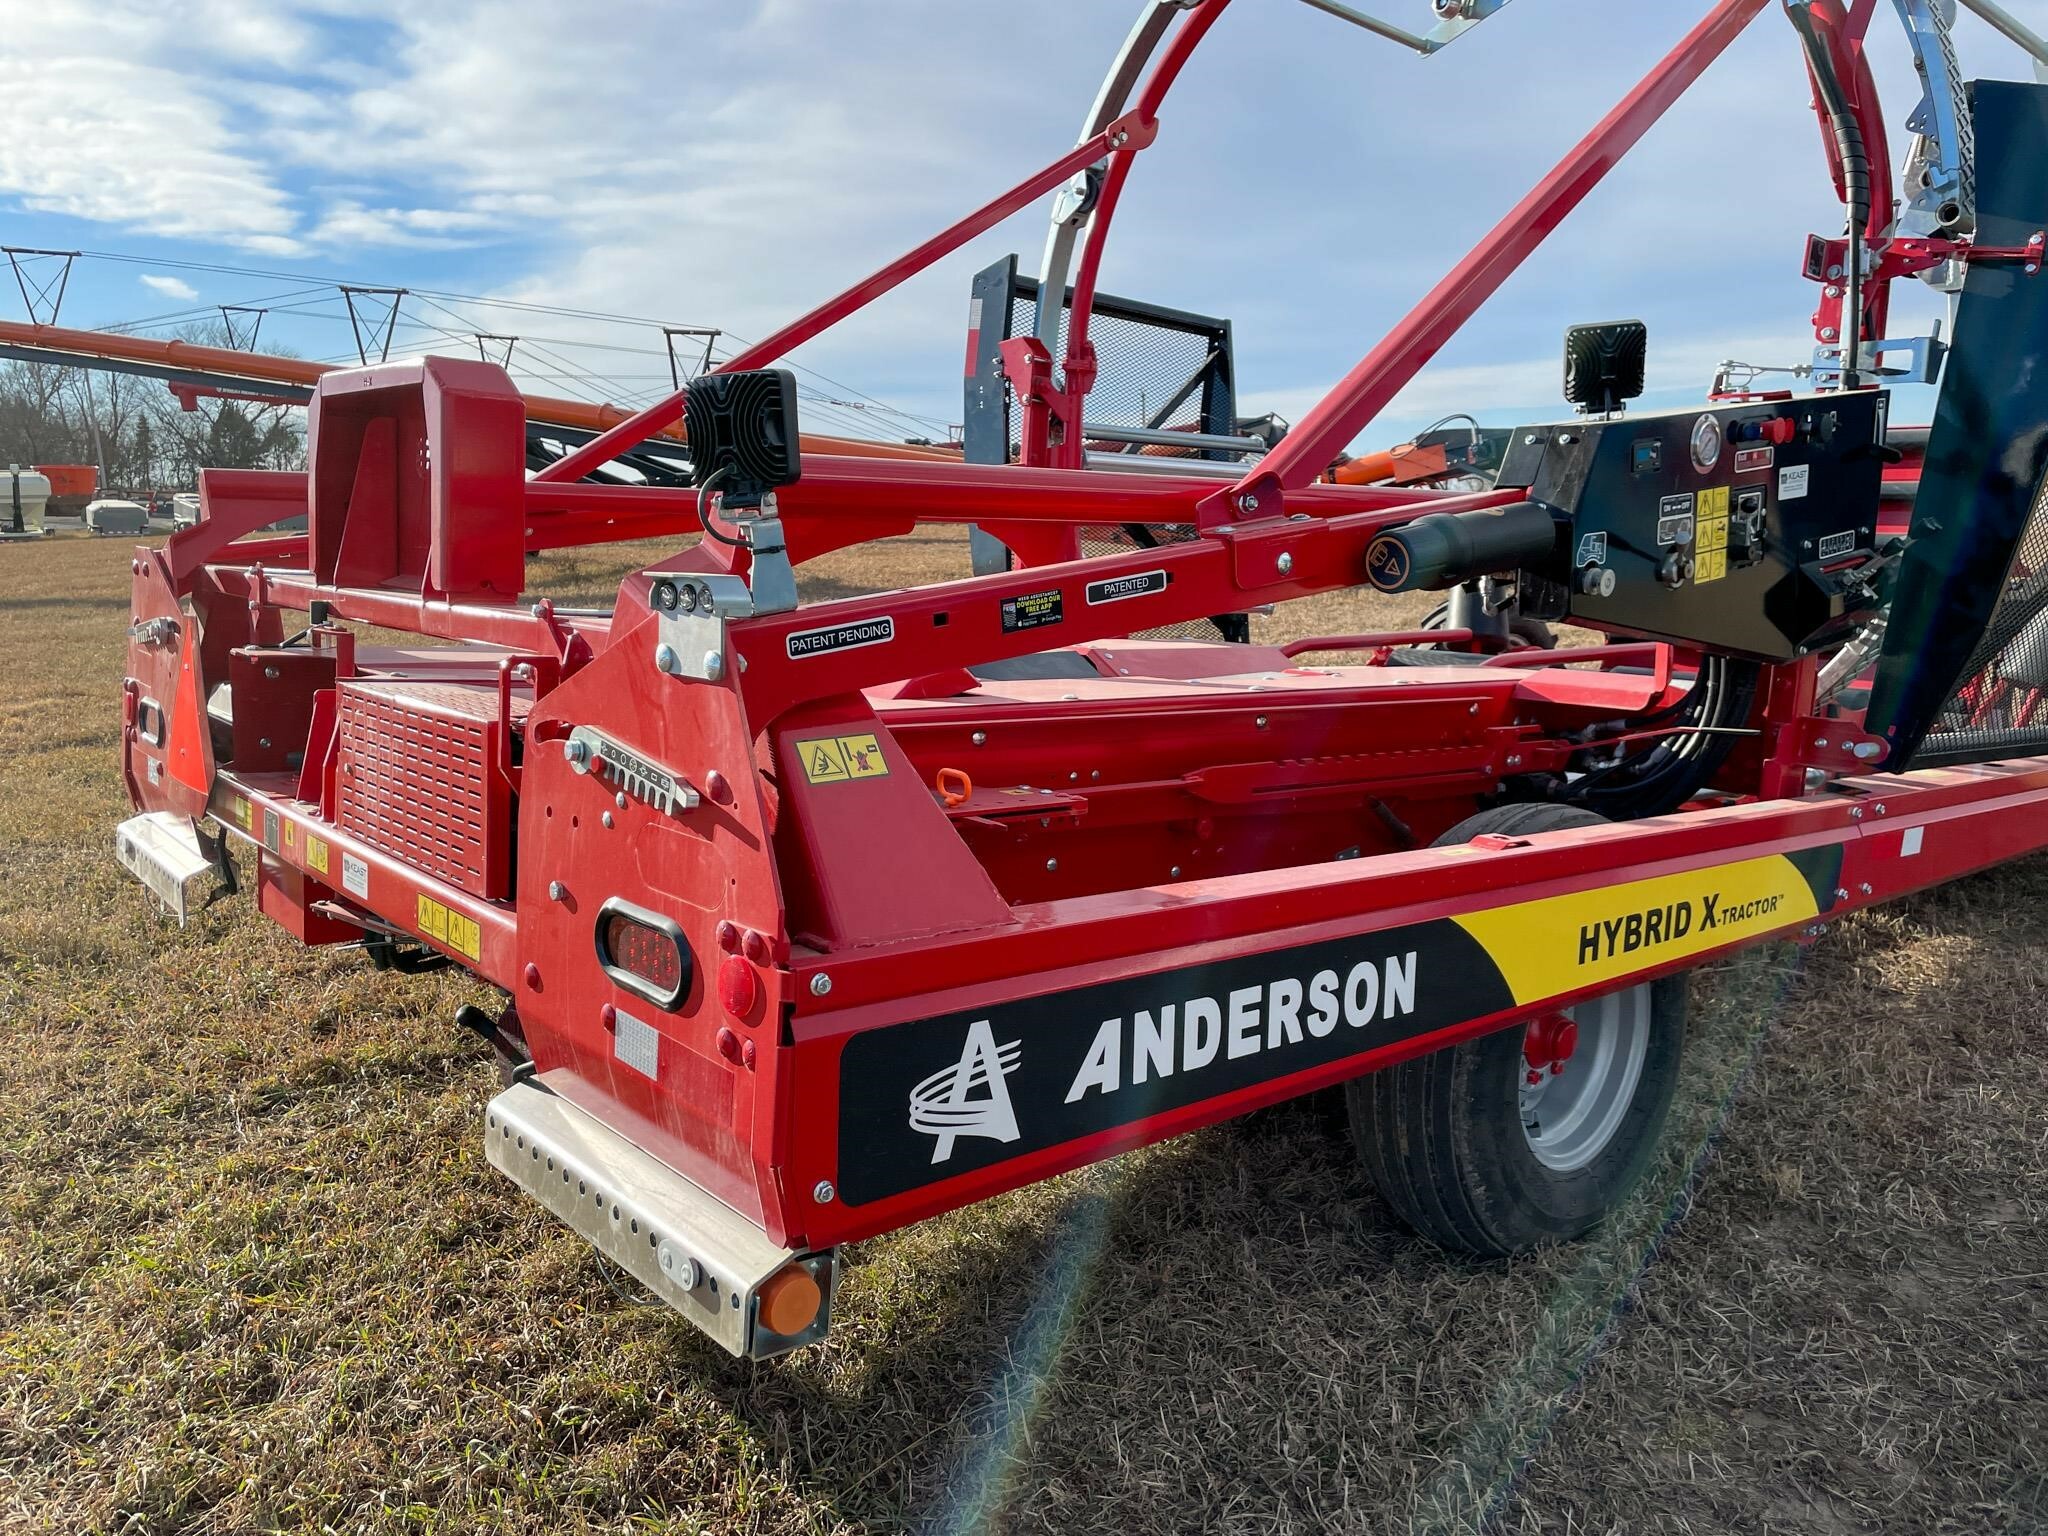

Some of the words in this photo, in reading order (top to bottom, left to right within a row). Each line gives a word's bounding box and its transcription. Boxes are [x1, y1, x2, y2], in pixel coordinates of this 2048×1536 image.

[1104, 577, 1149, 594] PATENTED
[1017, 597, 1048, 608] DOWNLOAD
[1048, 594, 1060, 602] OUR
[1025, 604, 1039, 613] FREE
[1040, 602, 1052, 610] APP
[791, 633, 835, 652] PATENT
[838, 623, 889, 643] PENDING
[1578, 901, 1692, 965] HYBRID
[1064, 951, 1418, 1104] ANDERSON
